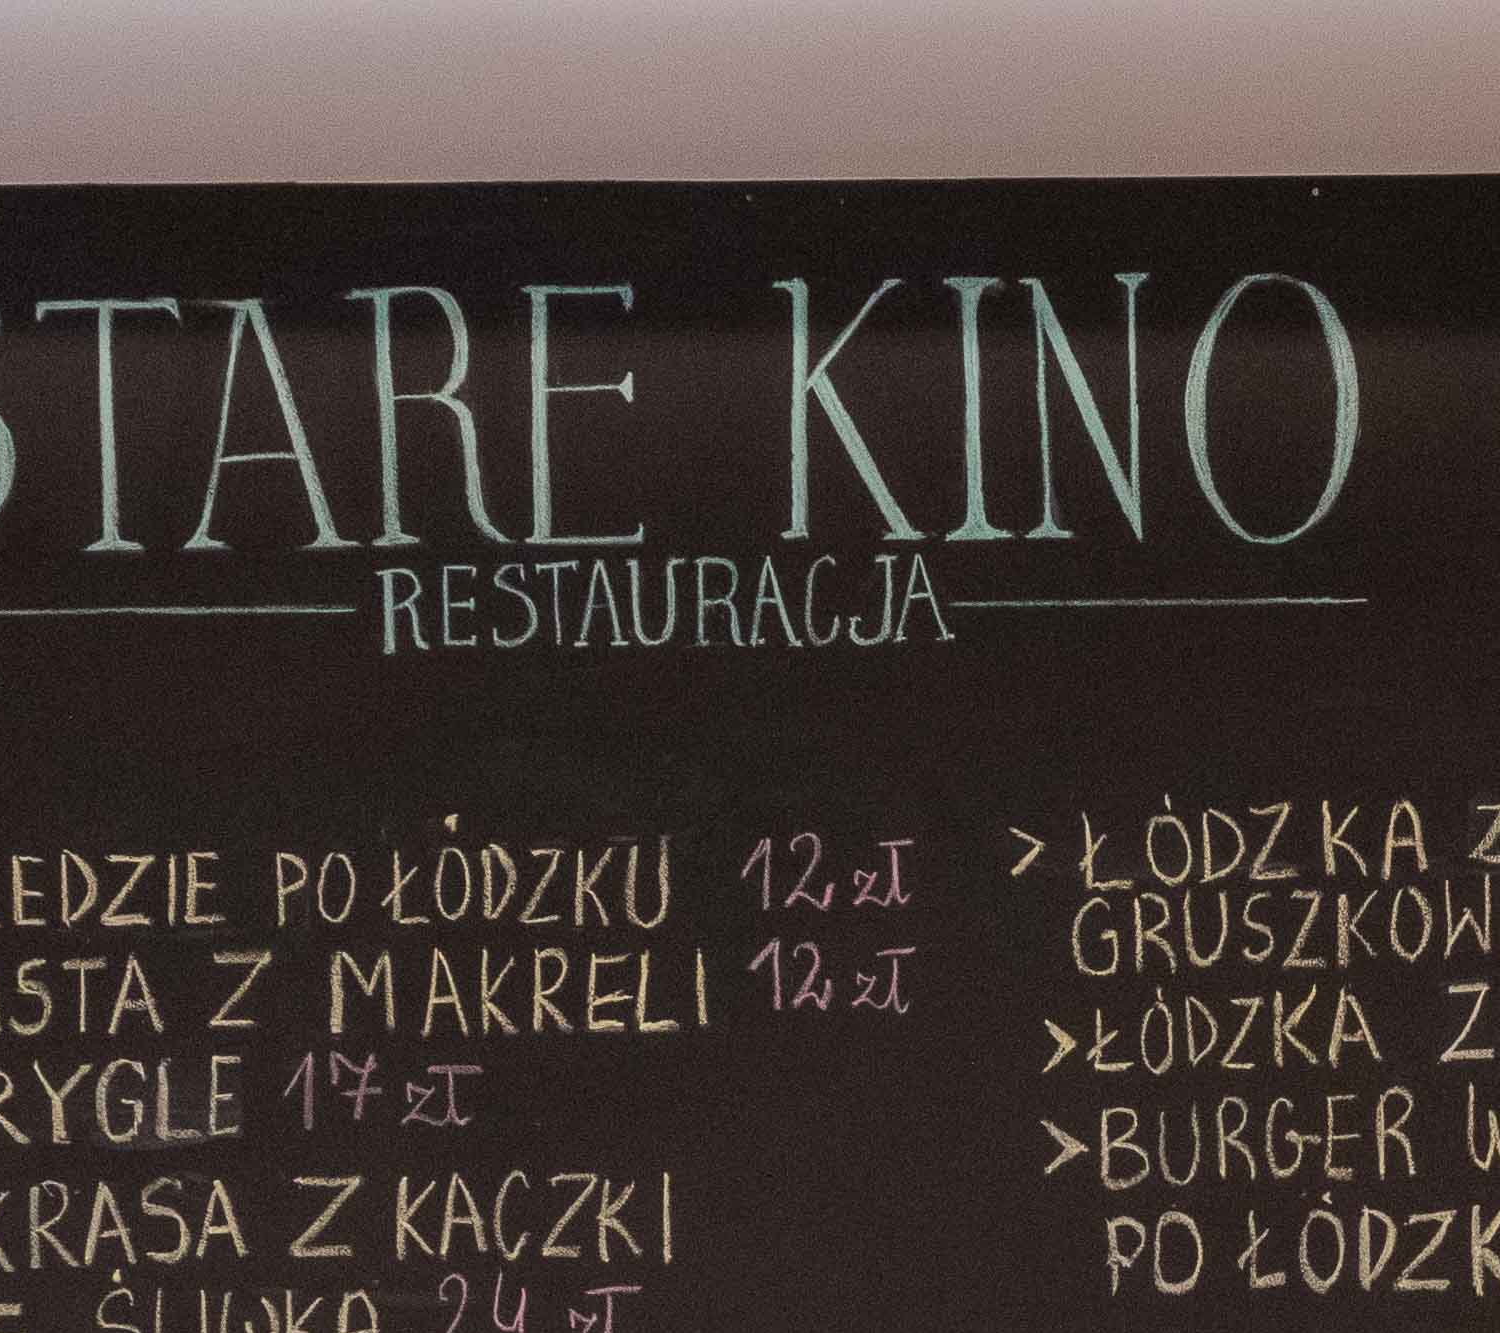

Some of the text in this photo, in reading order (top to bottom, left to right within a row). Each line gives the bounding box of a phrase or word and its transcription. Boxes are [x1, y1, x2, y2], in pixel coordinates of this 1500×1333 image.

[773, 273, 1359, 544] KINO
[377, 554, 955, 654] RESTAURACJA
[275, 852, 357, 926] PO
[381, 813, 670, 929] ŁÓDZKU
[742, 832, 835, 910] 12
[853, 839, 913, 906] zł
[1079, 794, 1429, 892] ŁÓDZKA
[209, 951, 272, 1027] Z
[329, 947, 708, 1036] MAKRELI
[749, 939, 832, 1010] 12
[852, 947, 915, 1014] zł
[1086, 985, 1382, 1075] ŁÓDZKA
[285, 1052, 381, 1129] 17
[402, 1065, 482, 1126] zł
[1100, 1086, 1416, 1191] BURGER
[289, 1175, 362, 1258] Z
[395, 1170, 673, 1264] KACZKI
[1106, 1211, 1204, 1295] PO
